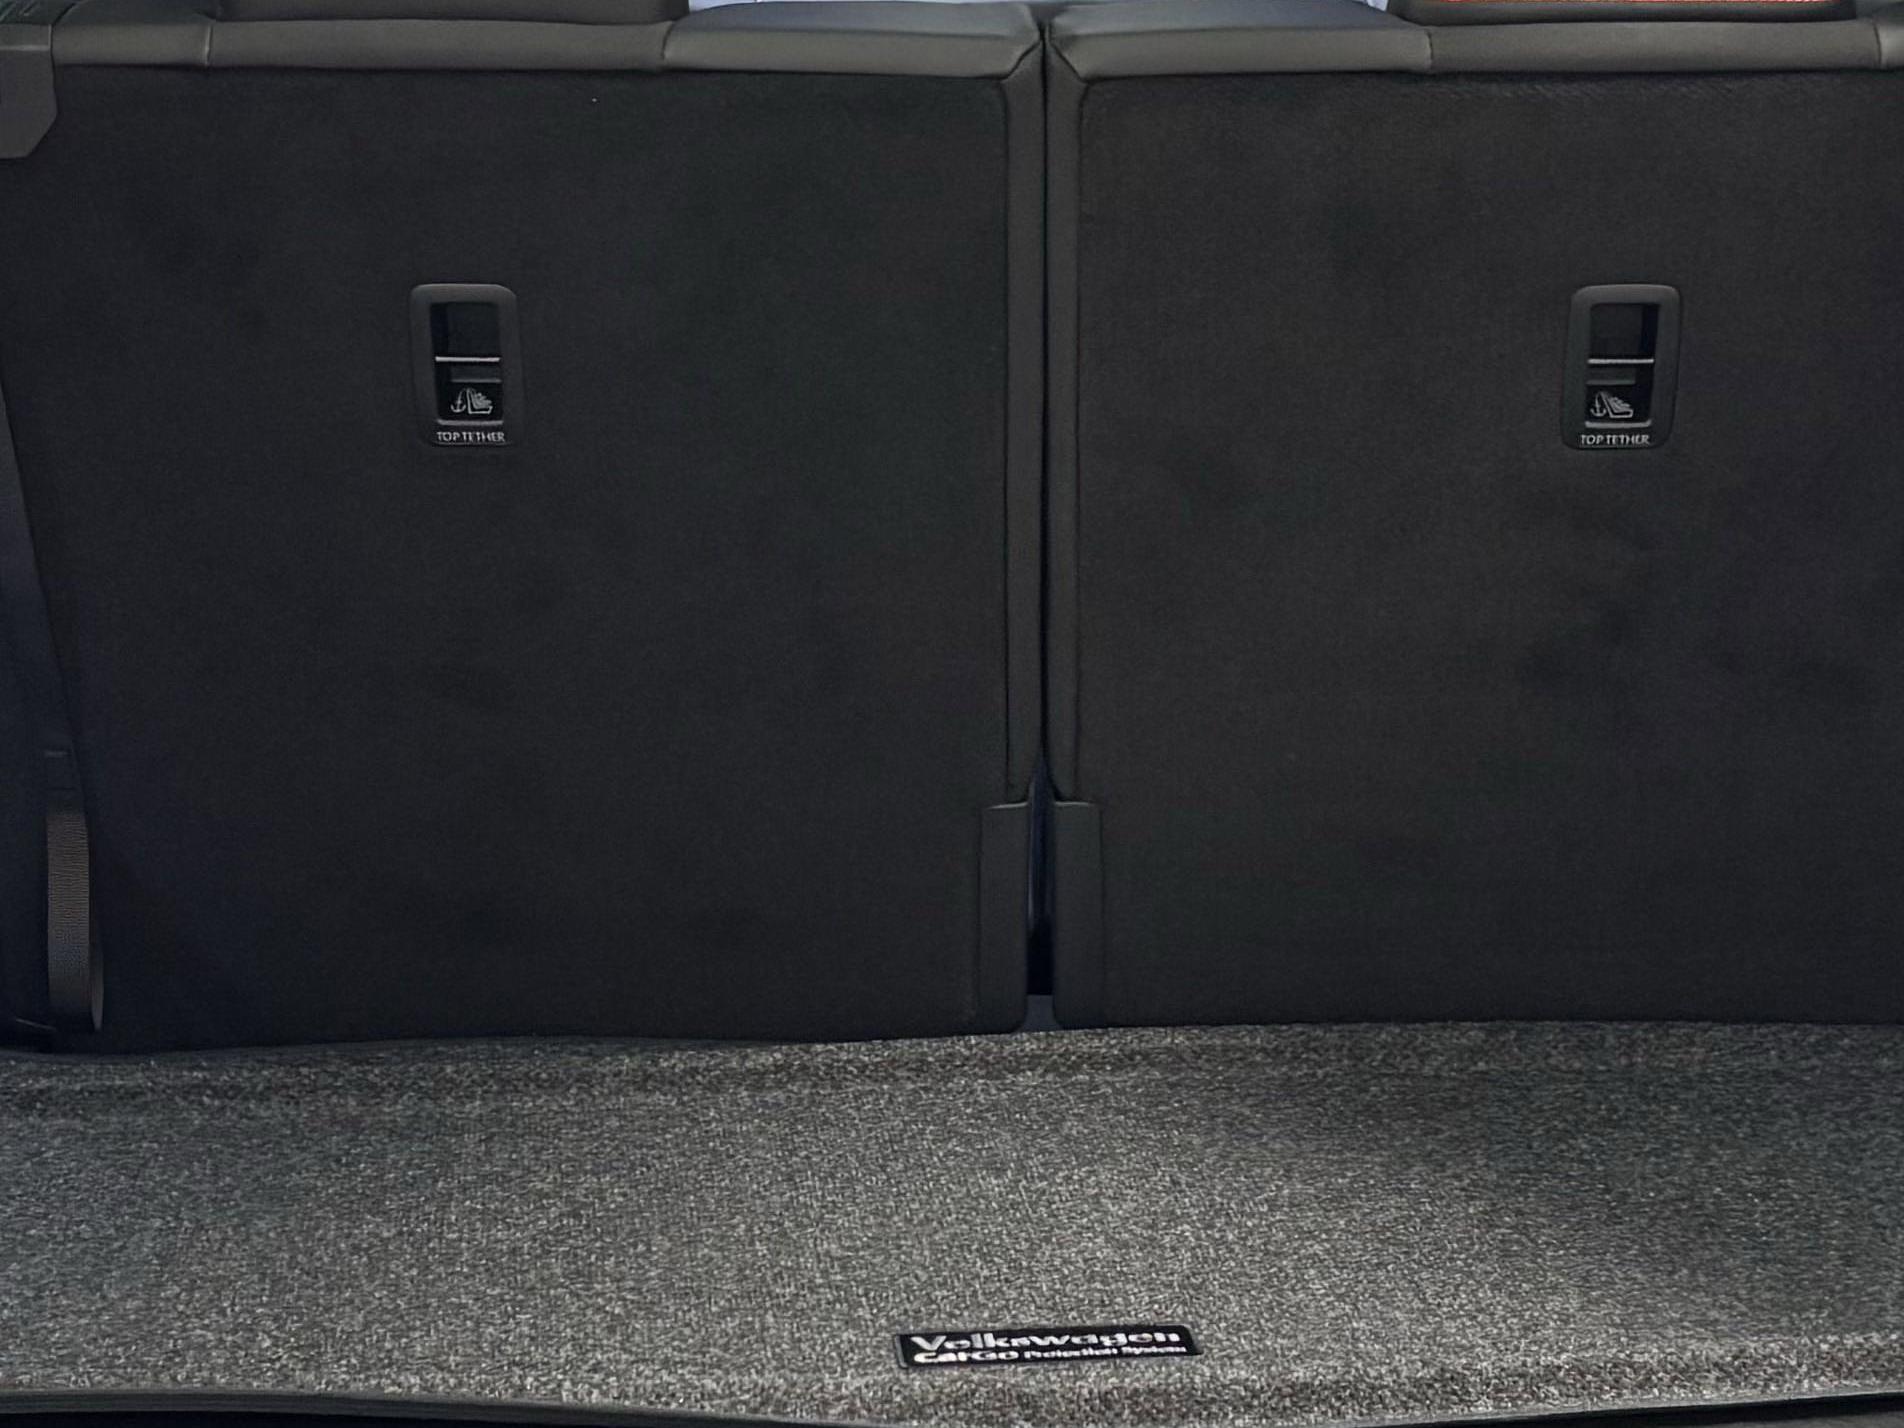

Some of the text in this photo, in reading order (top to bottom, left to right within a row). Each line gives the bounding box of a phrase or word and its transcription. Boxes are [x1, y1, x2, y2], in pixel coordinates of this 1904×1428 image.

[436, 431, 505, 442] TOP TETHER
[1580, 434, 1650, 445] TOP TETHER
[910, 1331, 1181, 1351] Volkswagen
